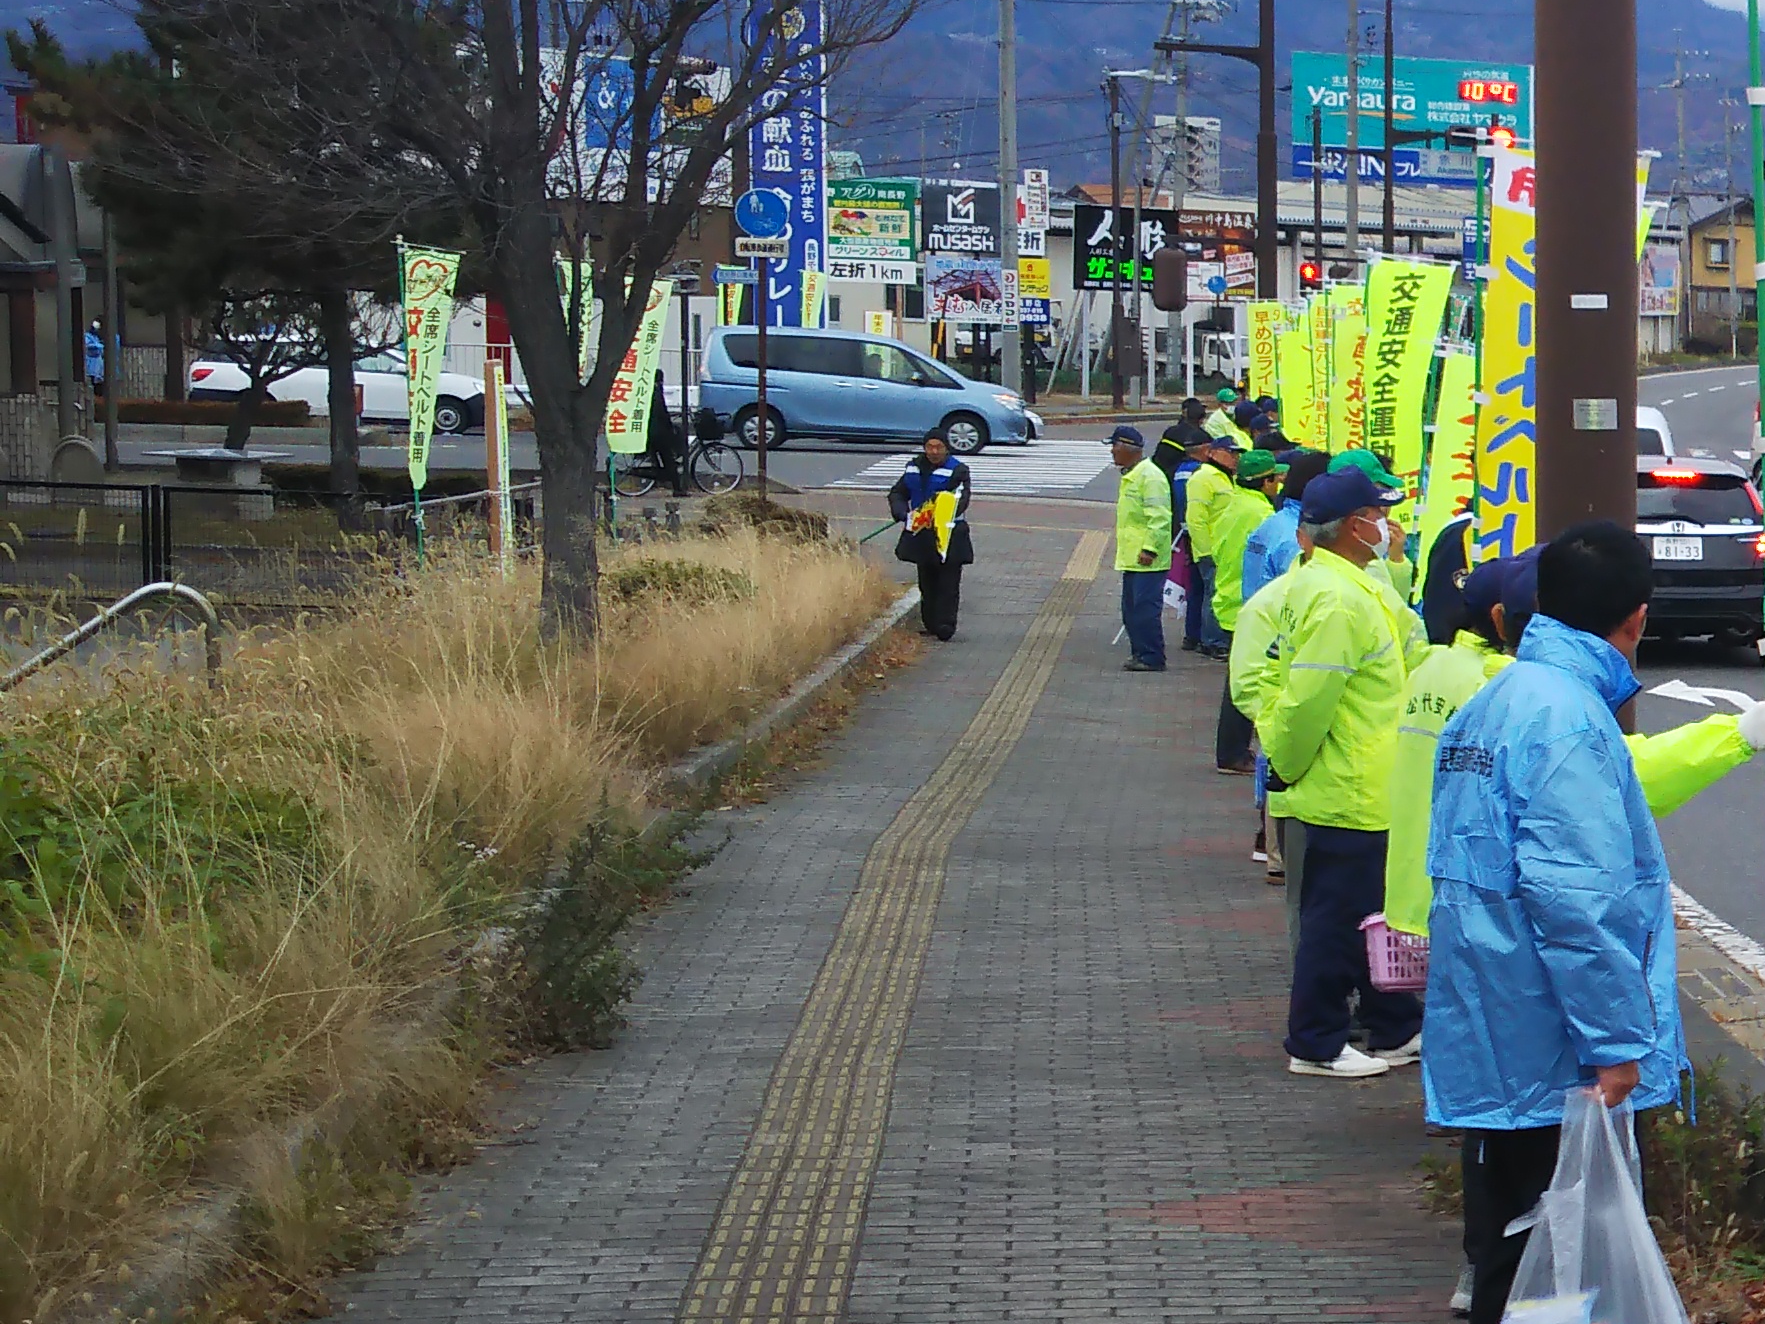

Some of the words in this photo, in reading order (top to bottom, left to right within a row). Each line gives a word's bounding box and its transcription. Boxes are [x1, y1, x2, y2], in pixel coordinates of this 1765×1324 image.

[411, 306, 442, 464] 全席シートベルト着用
